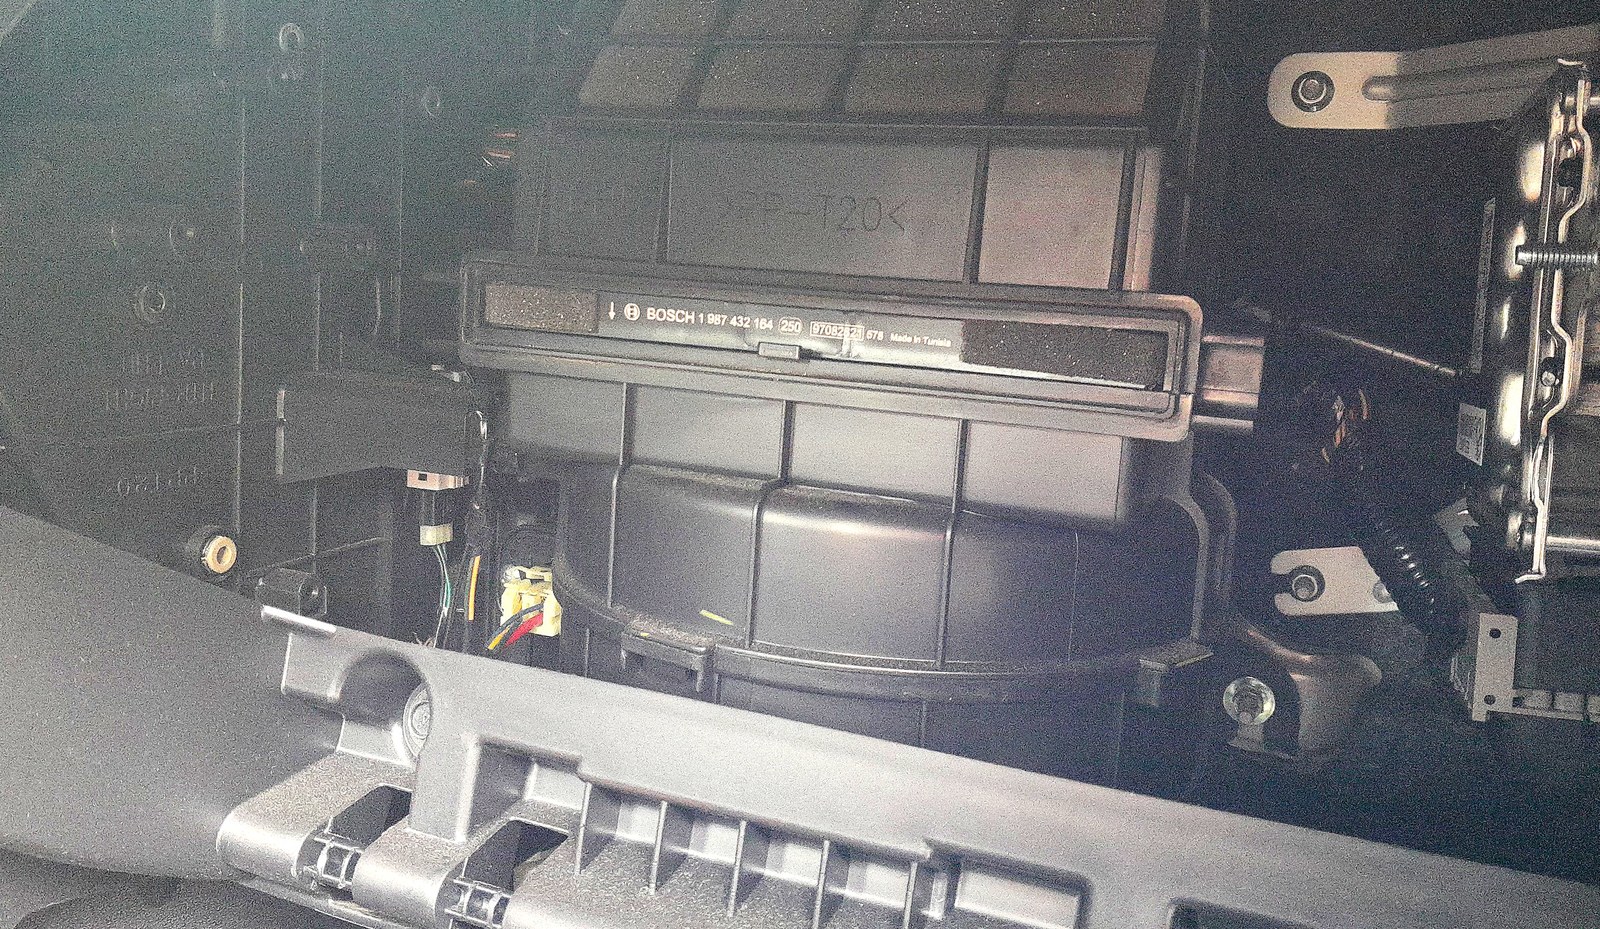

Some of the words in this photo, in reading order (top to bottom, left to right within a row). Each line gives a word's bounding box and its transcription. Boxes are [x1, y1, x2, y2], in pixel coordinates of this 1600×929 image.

[647, 307, 695, 324] BOSCH
[698, 313, 704, 324] 1
[708, 313, 728, 326] 987
[730, 315, 751, 329] 432
[754, 318, 774, 331] 164
[781, 319, 800, 332] 250
[890, 333, 912, 343] Made
